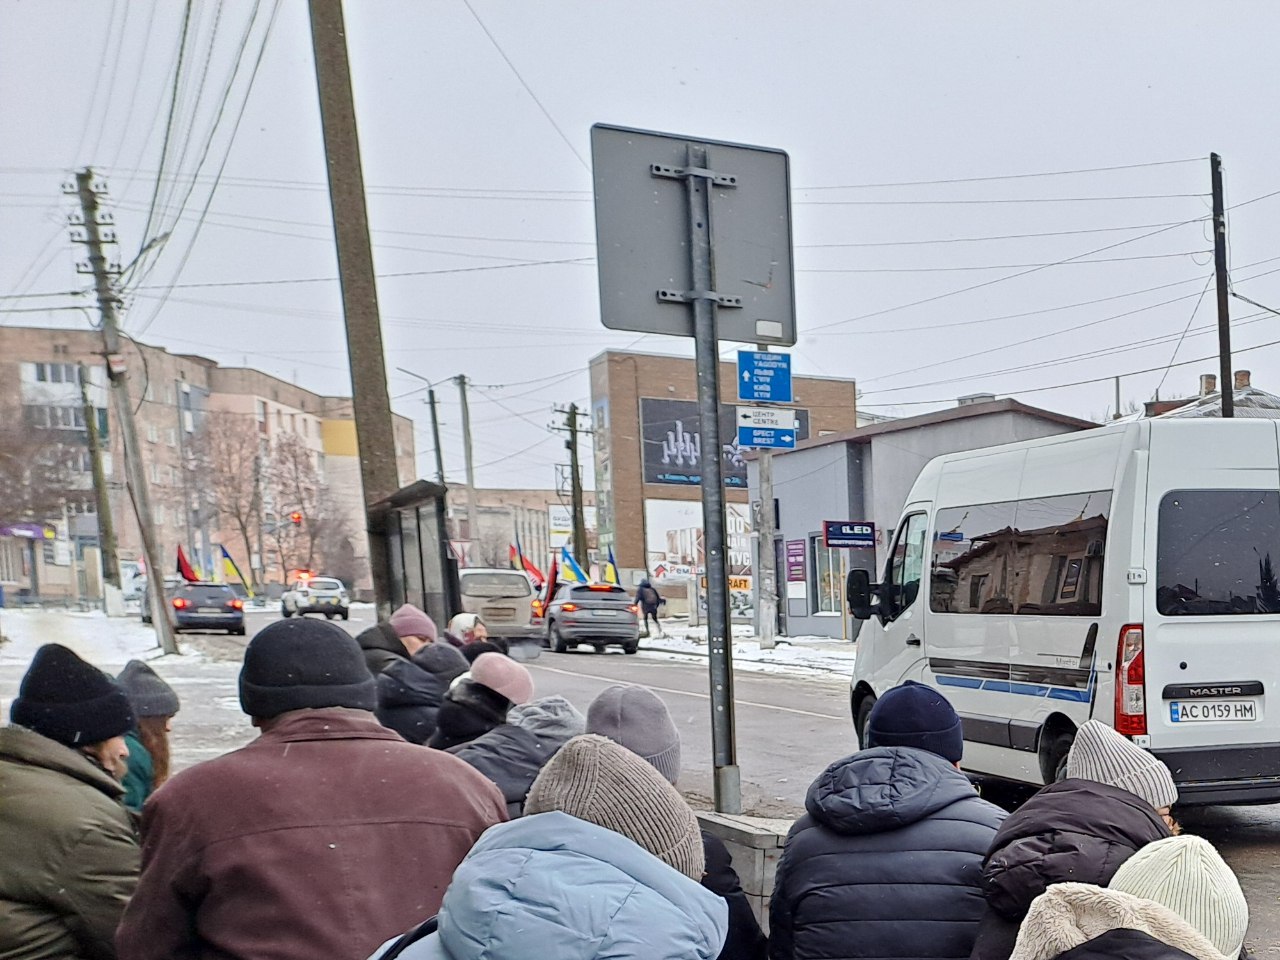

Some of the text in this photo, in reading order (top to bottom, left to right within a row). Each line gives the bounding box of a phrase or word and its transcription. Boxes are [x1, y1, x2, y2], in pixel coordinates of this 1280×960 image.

[1189, 687, 1242, 696] MASTER
[1181, 705, 1199, 718] AC
[1202, 704, 1231, 718] 0159
[1234, 704, 1253, 718] HM
